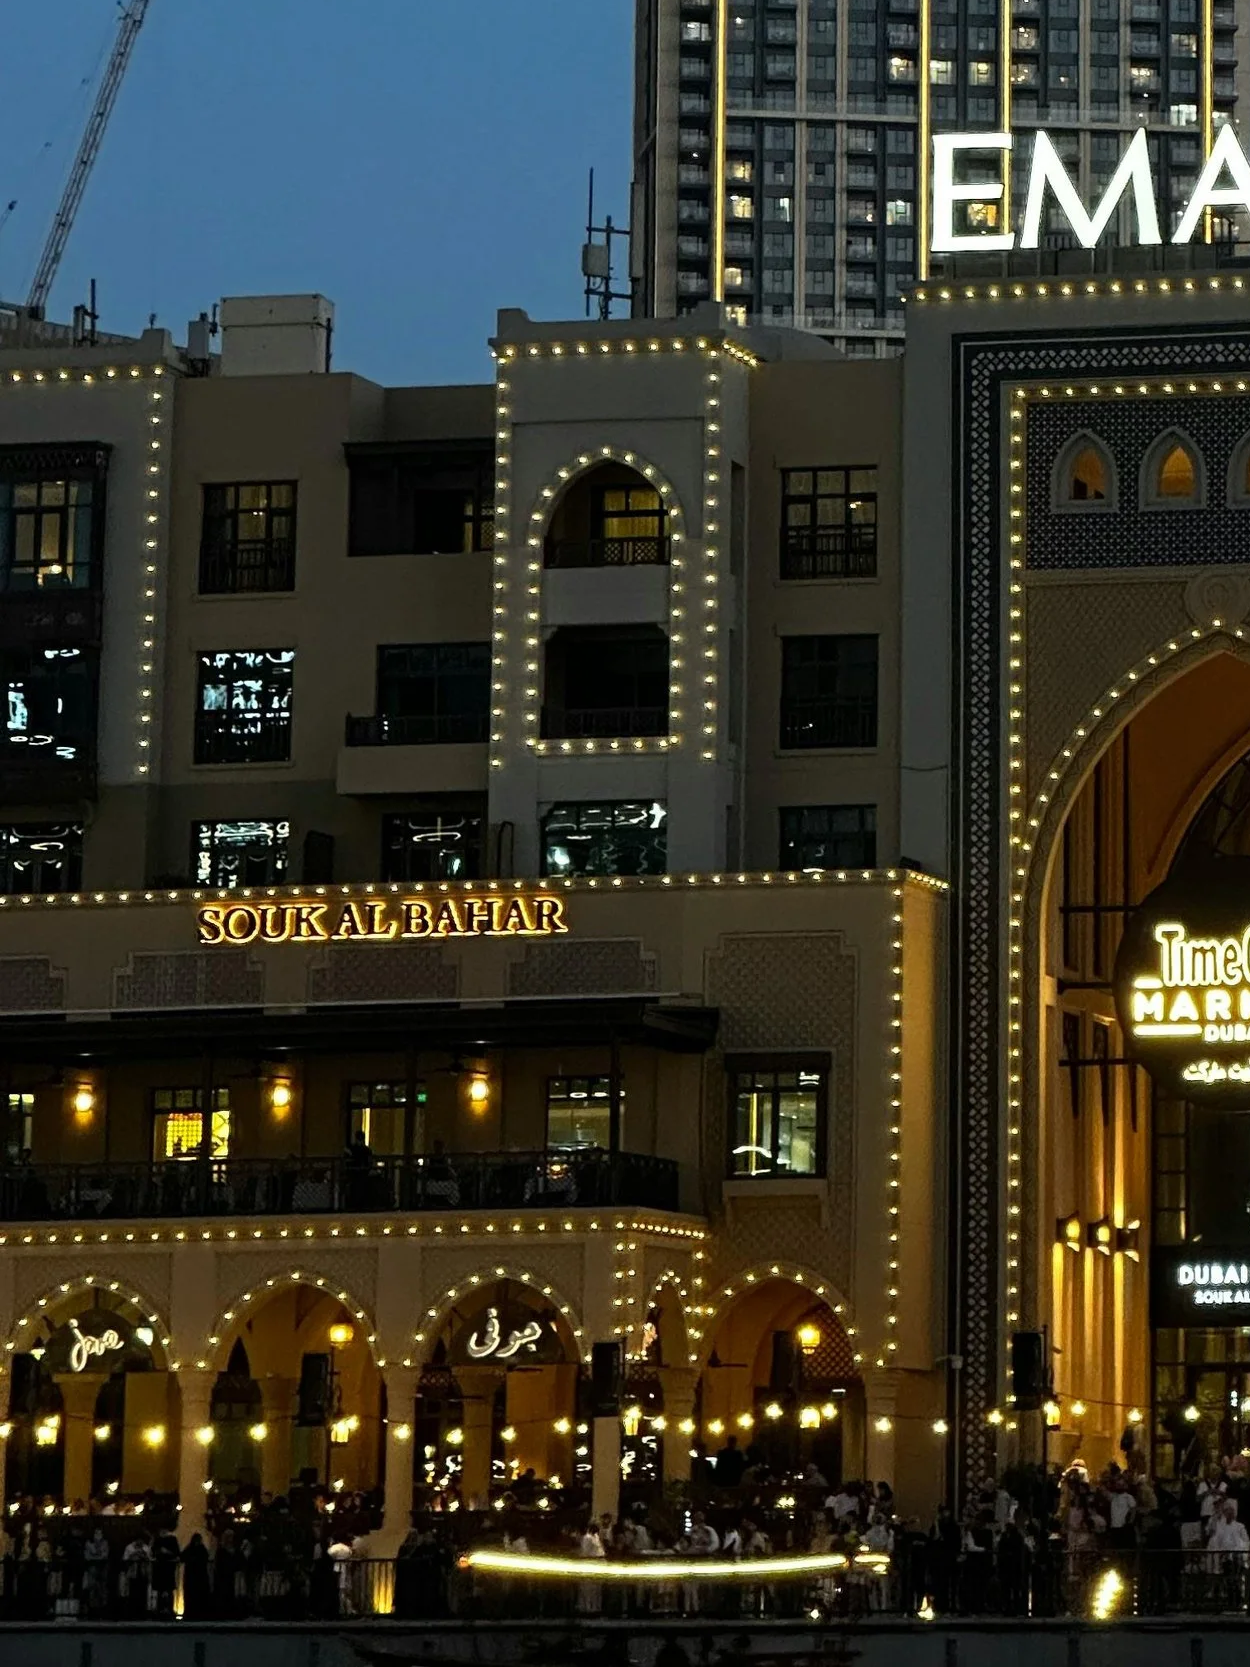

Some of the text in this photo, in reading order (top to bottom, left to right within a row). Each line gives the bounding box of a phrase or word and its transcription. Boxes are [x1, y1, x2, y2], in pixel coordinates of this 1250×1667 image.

[200, 896, 569, 943] SOUK AL BAHAR
[1178, 1264, 1248, 1285] DUBAI
[1194, 1289, 1233, 1304] SOUK
